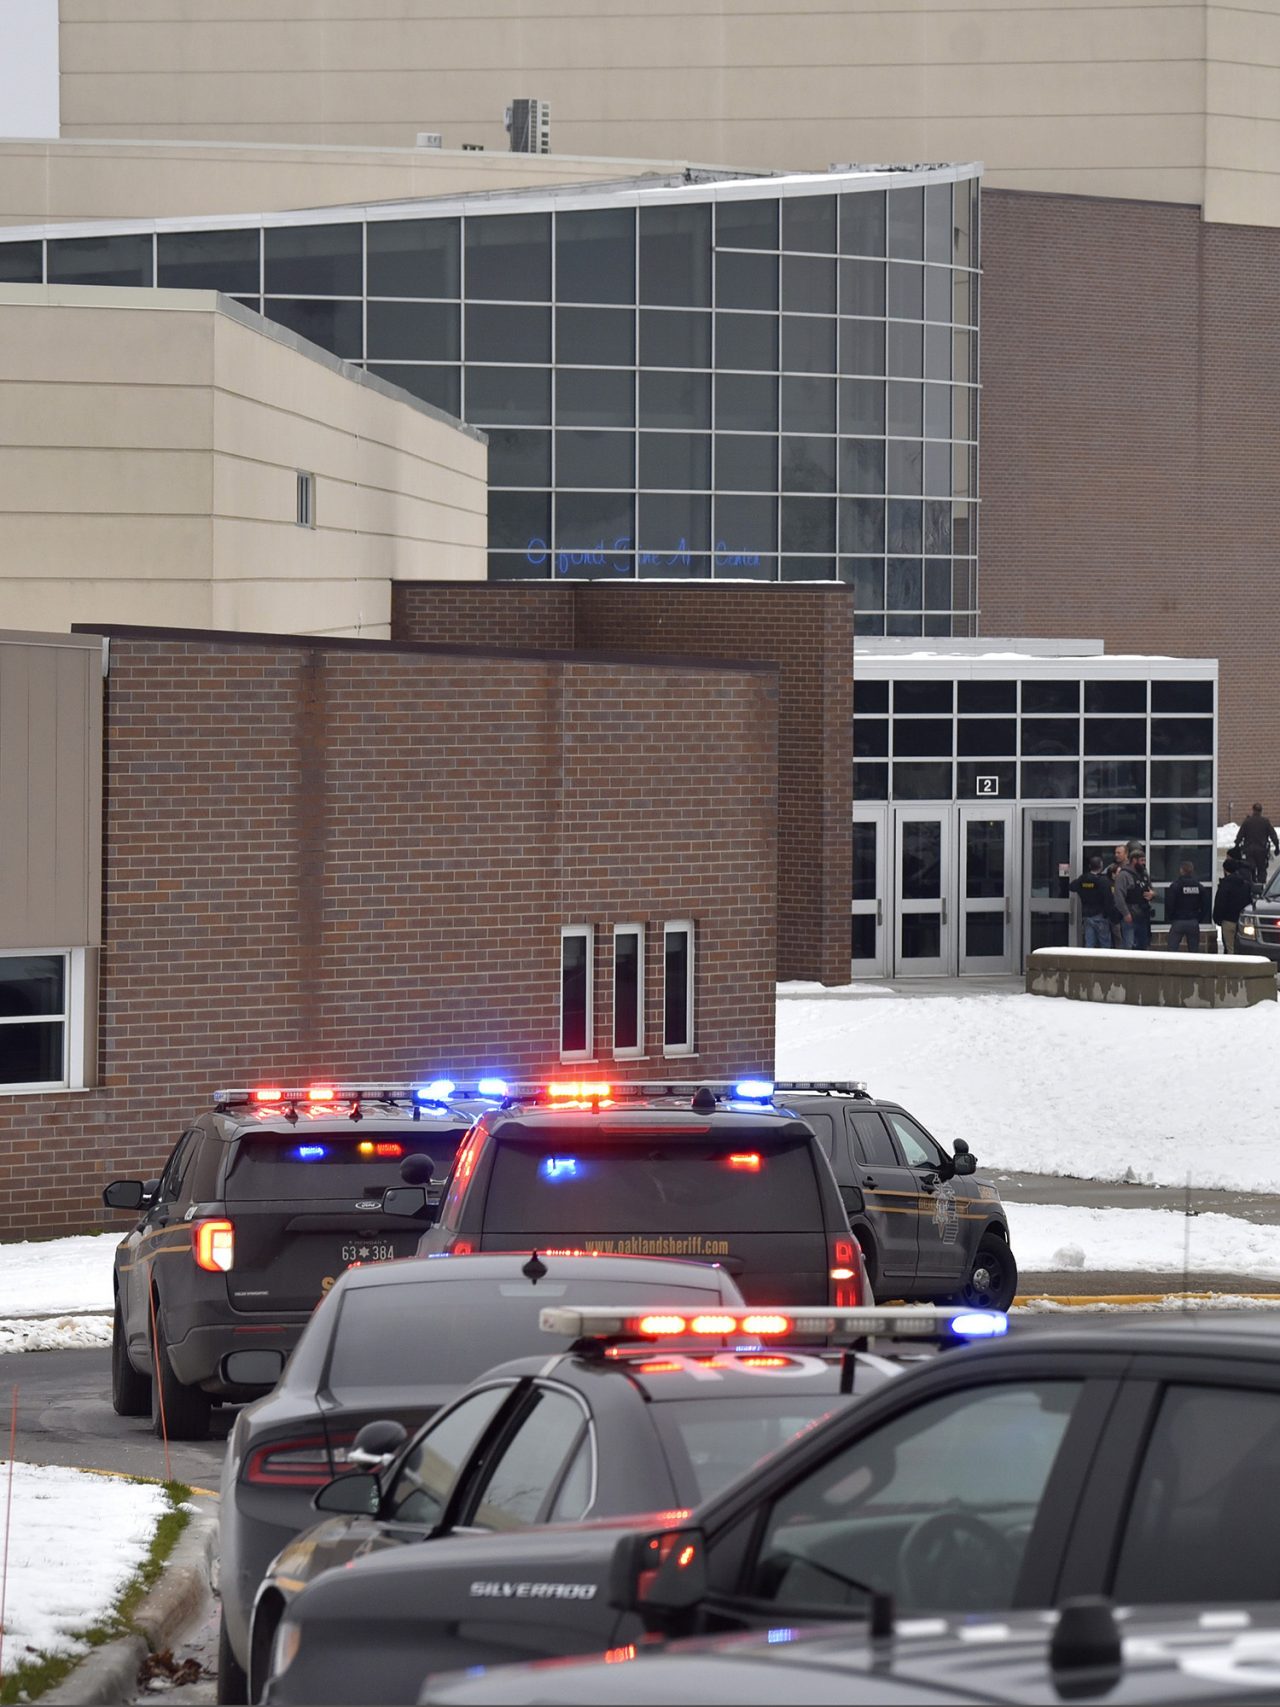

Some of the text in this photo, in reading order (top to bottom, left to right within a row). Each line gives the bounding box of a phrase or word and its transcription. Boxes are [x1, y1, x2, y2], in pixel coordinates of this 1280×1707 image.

[527, 537, 606, 573] Oford
[983, 779, 992, 792] 2
[342, 1245, 394, 1260] 63 384
[585, 1236, 729, 1255] www.oaklandsheriff.com
[470, 1581, 598, 1600] SILVERADO
